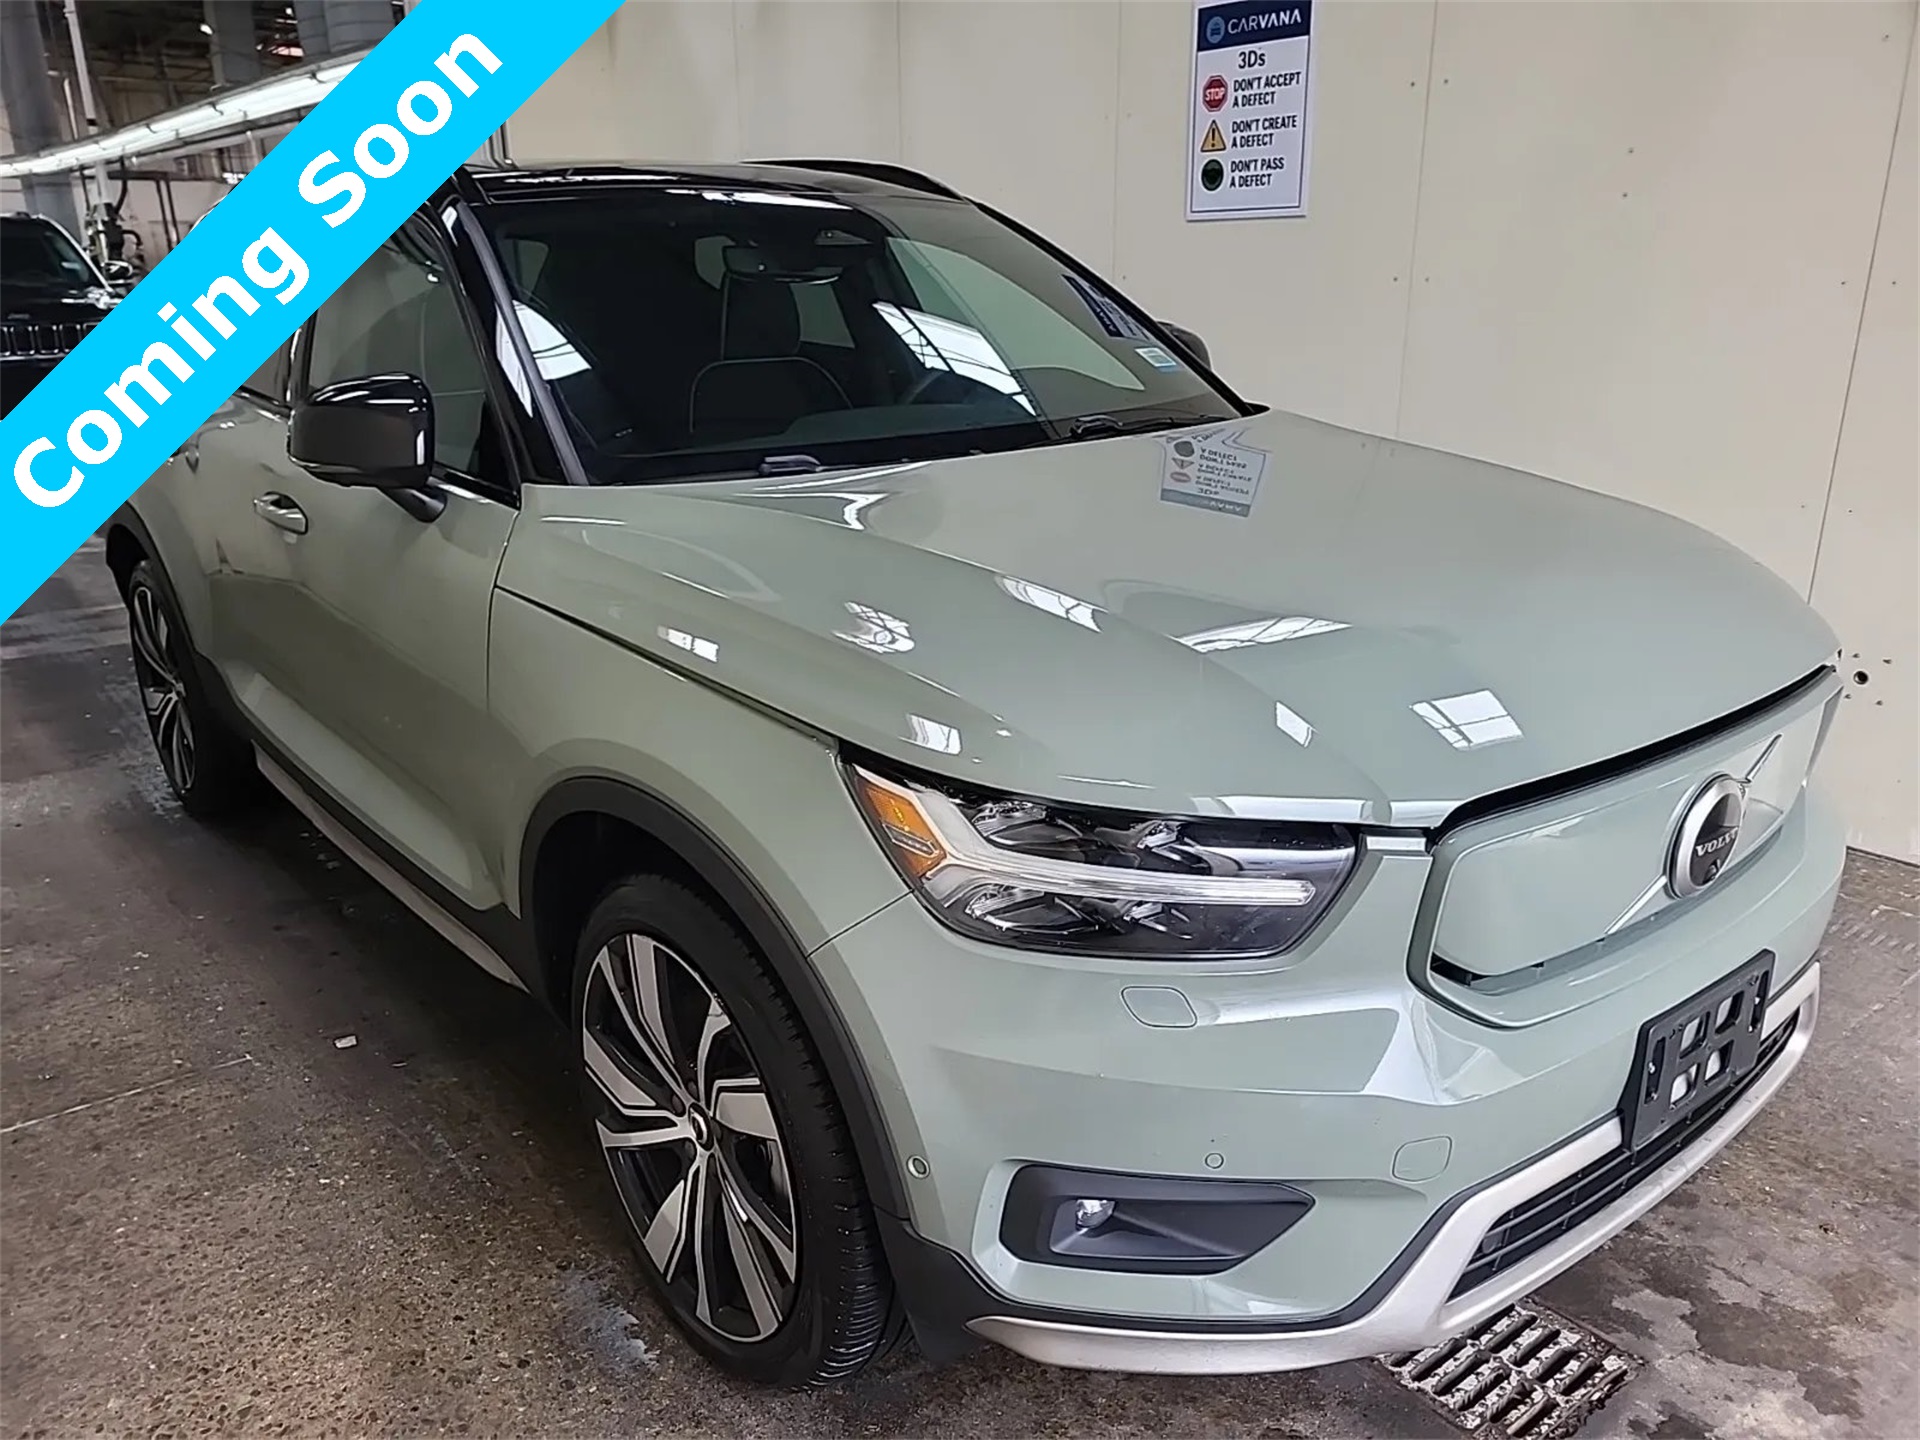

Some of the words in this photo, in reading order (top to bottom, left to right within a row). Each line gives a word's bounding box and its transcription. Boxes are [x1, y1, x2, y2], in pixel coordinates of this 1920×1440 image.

[1227, 8, 1302, 34] CARVANA
[1238, 49, 1266, 69] 3Ds
[1233, 76, 1262, 92] DON'T
[1263, 71, 1301, 88] ACCEPT
[1205, 87, 1226, 101] STOP
[1232, 95, 1240, 108] A
[1241, 91, 1276, 107] DEFECT
[1231, 118, 1260, 134] DON'T
[1261, 114, 1298, 130] CREATE
[1231, 136, 1238, 149] A
[1240, 132, 1274, 148] DEFECT
[1230, 159, 1259, 173] DON'T
[1260, 157, 1285, 171] PASS
[1229, 176, 1237, 188] A
[1238, 173, 1273, 188] DEFECT
